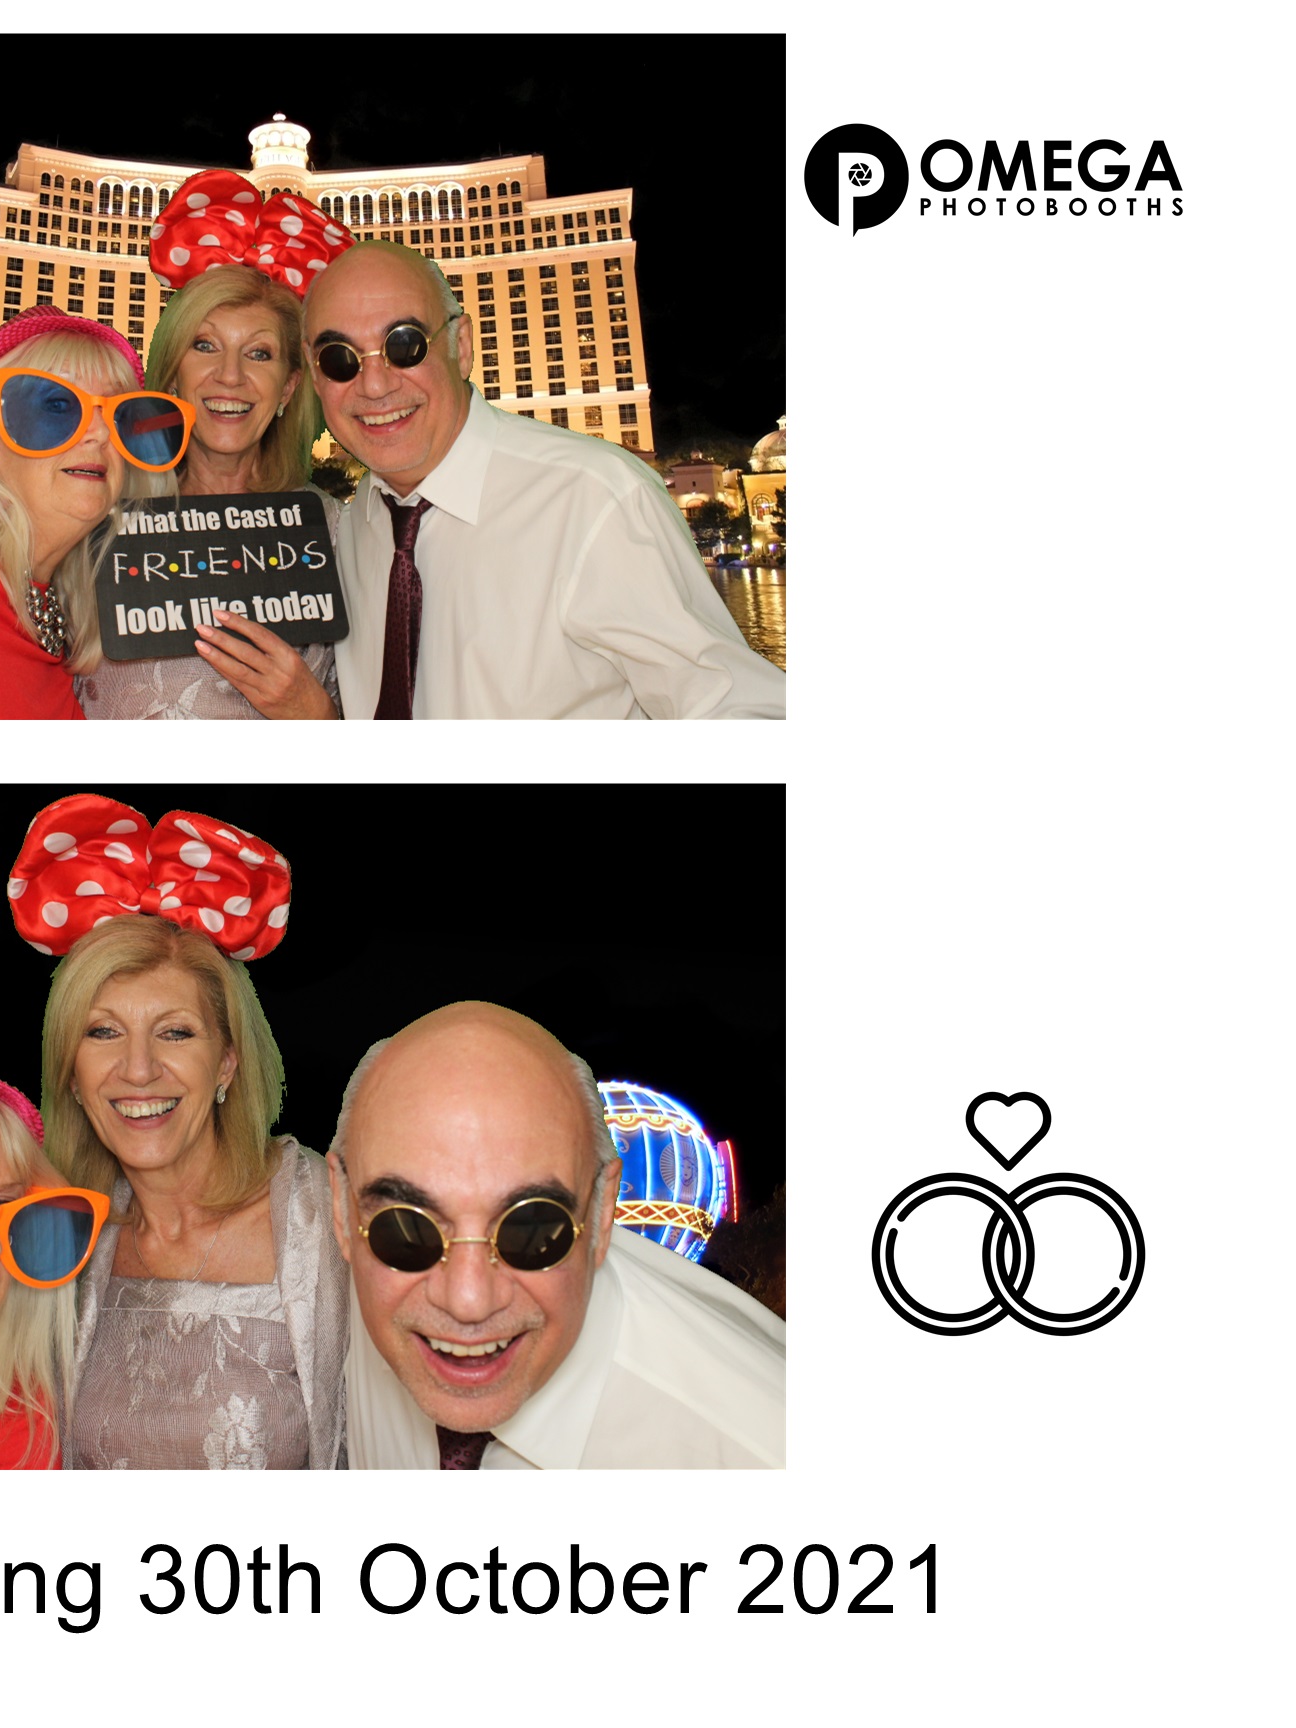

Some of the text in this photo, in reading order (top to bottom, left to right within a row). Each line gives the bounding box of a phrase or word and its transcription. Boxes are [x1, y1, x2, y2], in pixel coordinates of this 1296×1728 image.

[115, 504, 303, 536] What the Cast of
[115, 590, 335, 636] look like today
